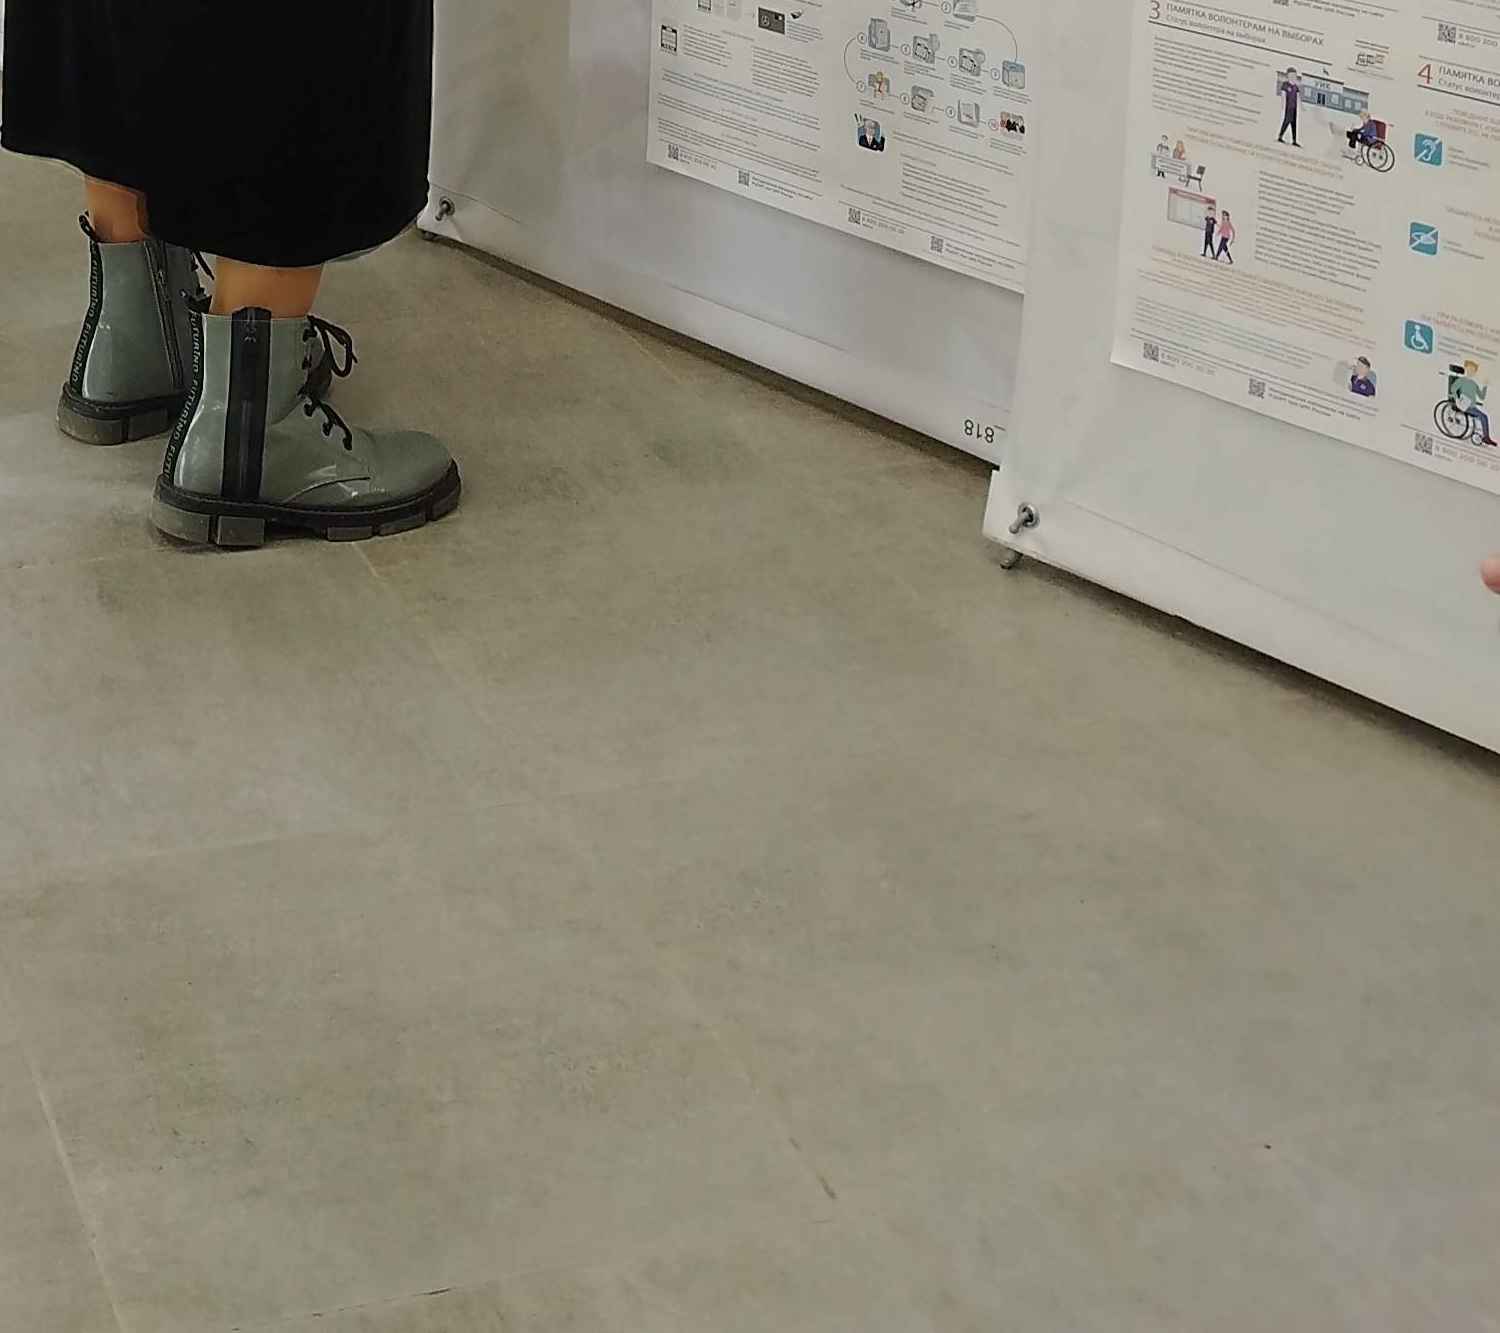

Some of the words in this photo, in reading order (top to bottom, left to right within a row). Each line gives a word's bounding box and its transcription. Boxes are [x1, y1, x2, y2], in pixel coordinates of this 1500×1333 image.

[1149, 0, 1161, 20] 3
[1166, 2, 1207, 19] ПАМЯТКА
[1208, 12, 1267, 33] ВОЛОНТЕРАМ
[1267, 26, 1281, 36] НА
[1282, 29, 1325, 47] ВЫБОРАХ
[964, 419, 995, 444] 818
